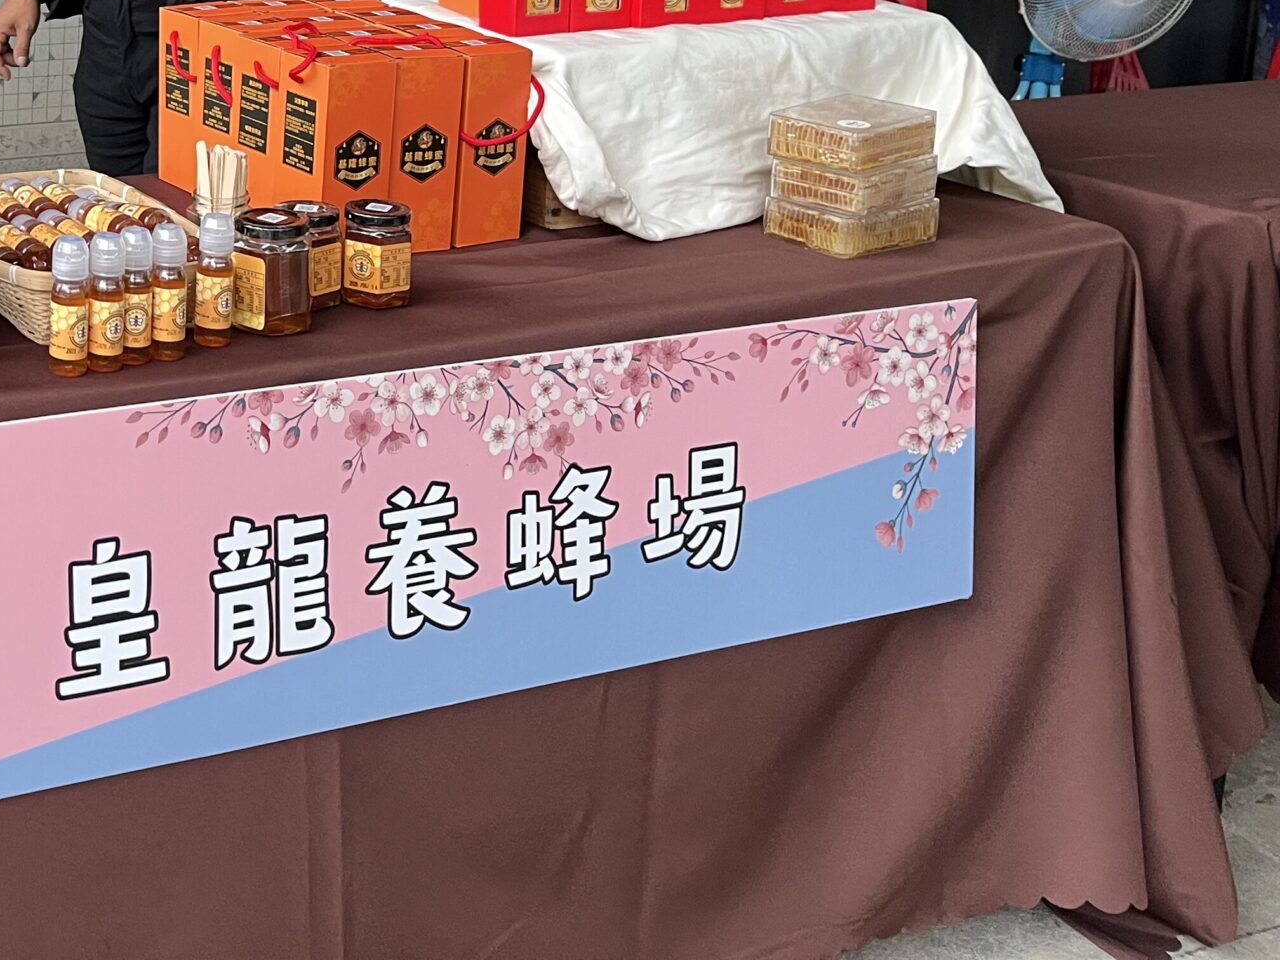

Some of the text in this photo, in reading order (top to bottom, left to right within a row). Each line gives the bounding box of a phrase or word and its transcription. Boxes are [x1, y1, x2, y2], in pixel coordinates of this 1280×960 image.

[56, 442, 746, 700] 皇龍養蜂場
